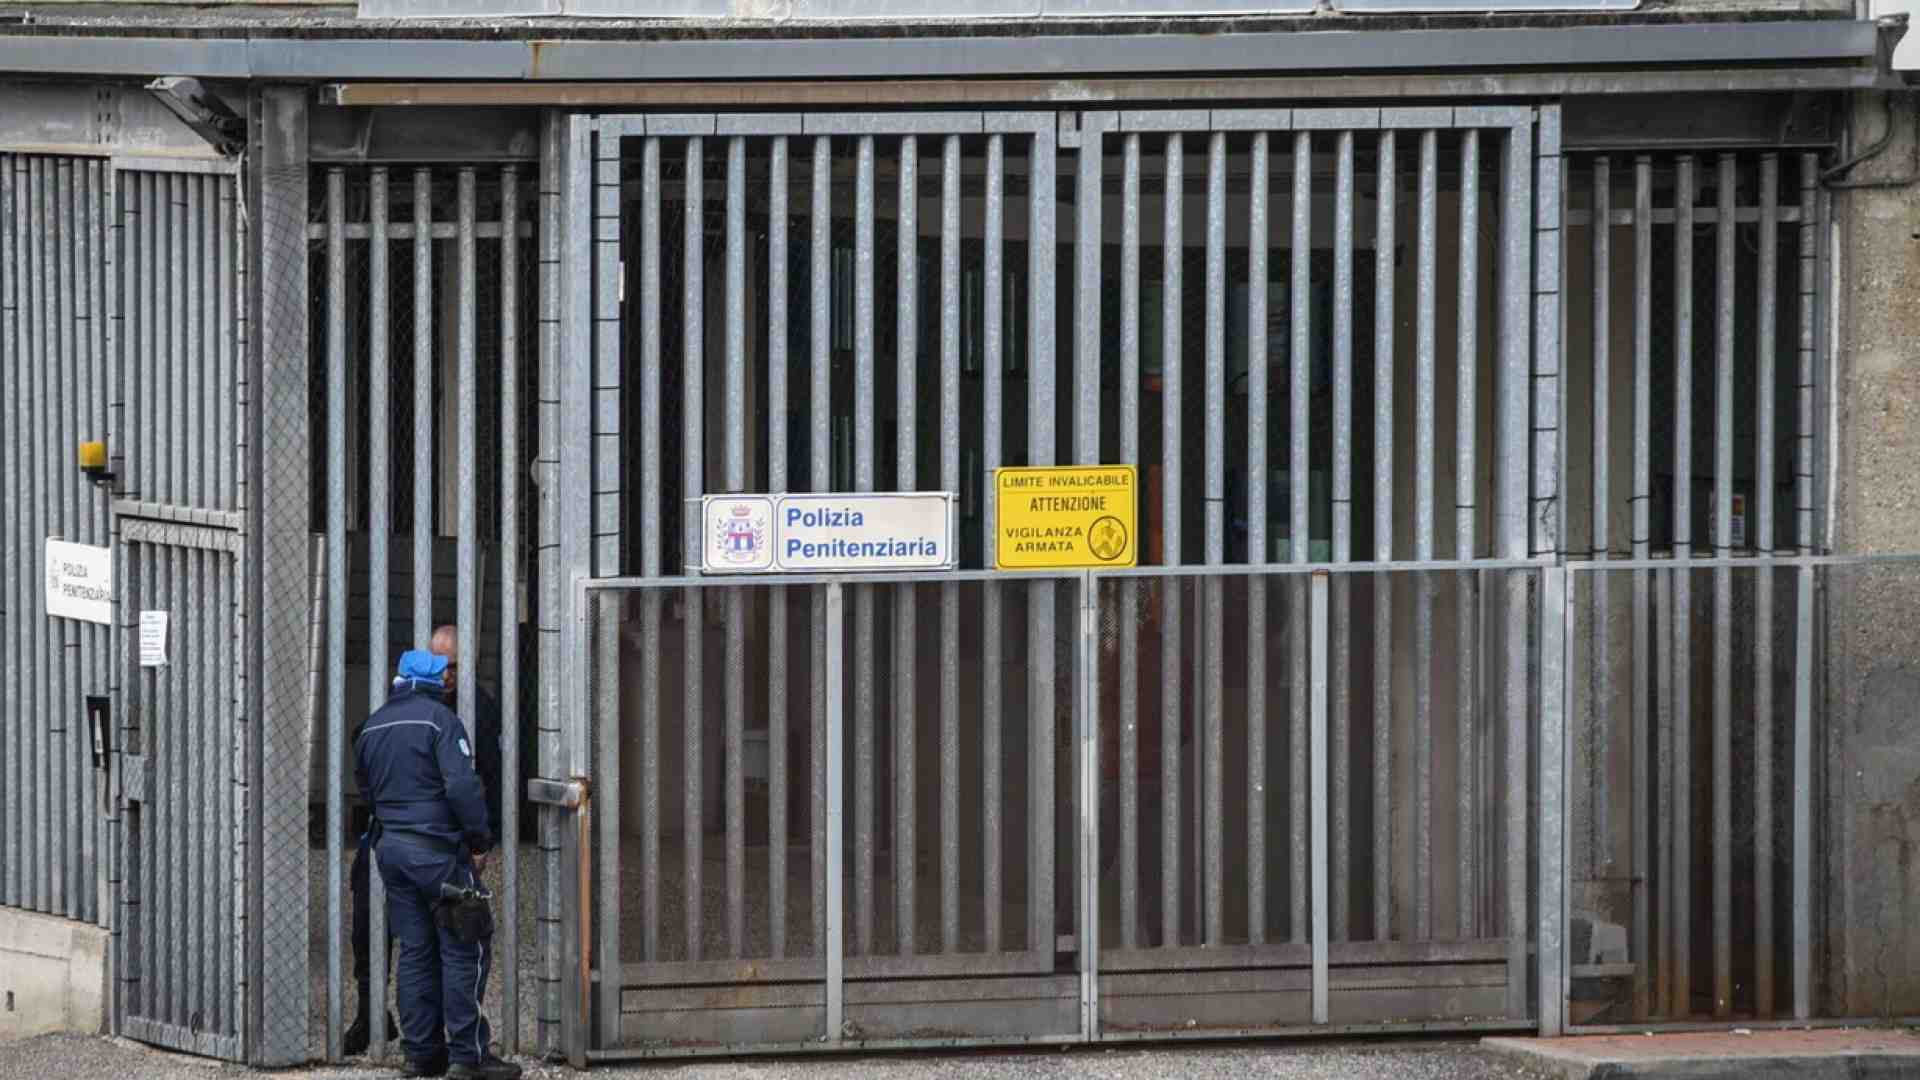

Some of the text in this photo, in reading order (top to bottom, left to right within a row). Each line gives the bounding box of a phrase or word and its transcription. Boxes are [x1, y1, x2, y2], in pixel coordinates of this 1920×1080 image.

[1003, 475, 1128, 488] LIMITE INVALICABILE
[1029, 496, 1107, 512] ATTENZIONE
[787, 507, 864, 527] Polizia
[1005, 526, 1083, 538] VIGILANZA
[787, 537, 937, 558] Penitenziaria
[1015, 541, 1074, 553] ARMATA
